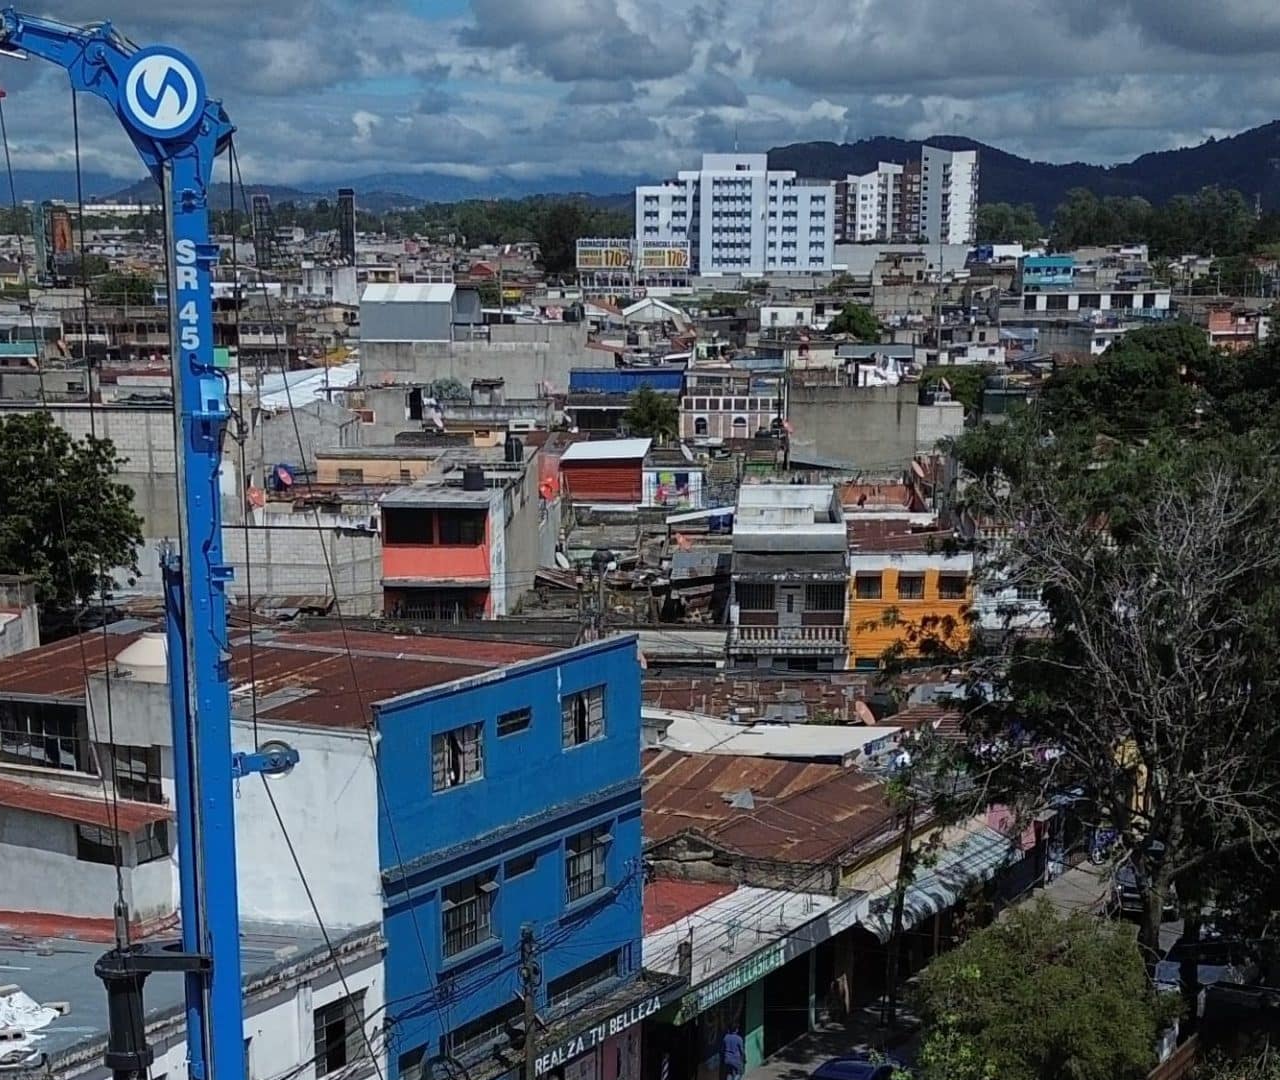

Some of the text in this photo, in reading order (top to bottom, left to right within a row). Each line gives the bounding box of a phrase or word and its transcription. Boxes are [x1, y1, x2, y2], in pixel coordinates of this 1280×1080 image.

[175, 239, 200, 350] SR 45
[534, 1035, 585, 1078] REALZA
[589, 1023, 606, 1046] TU
[609, 995, 661, 1036] BELLEZA
